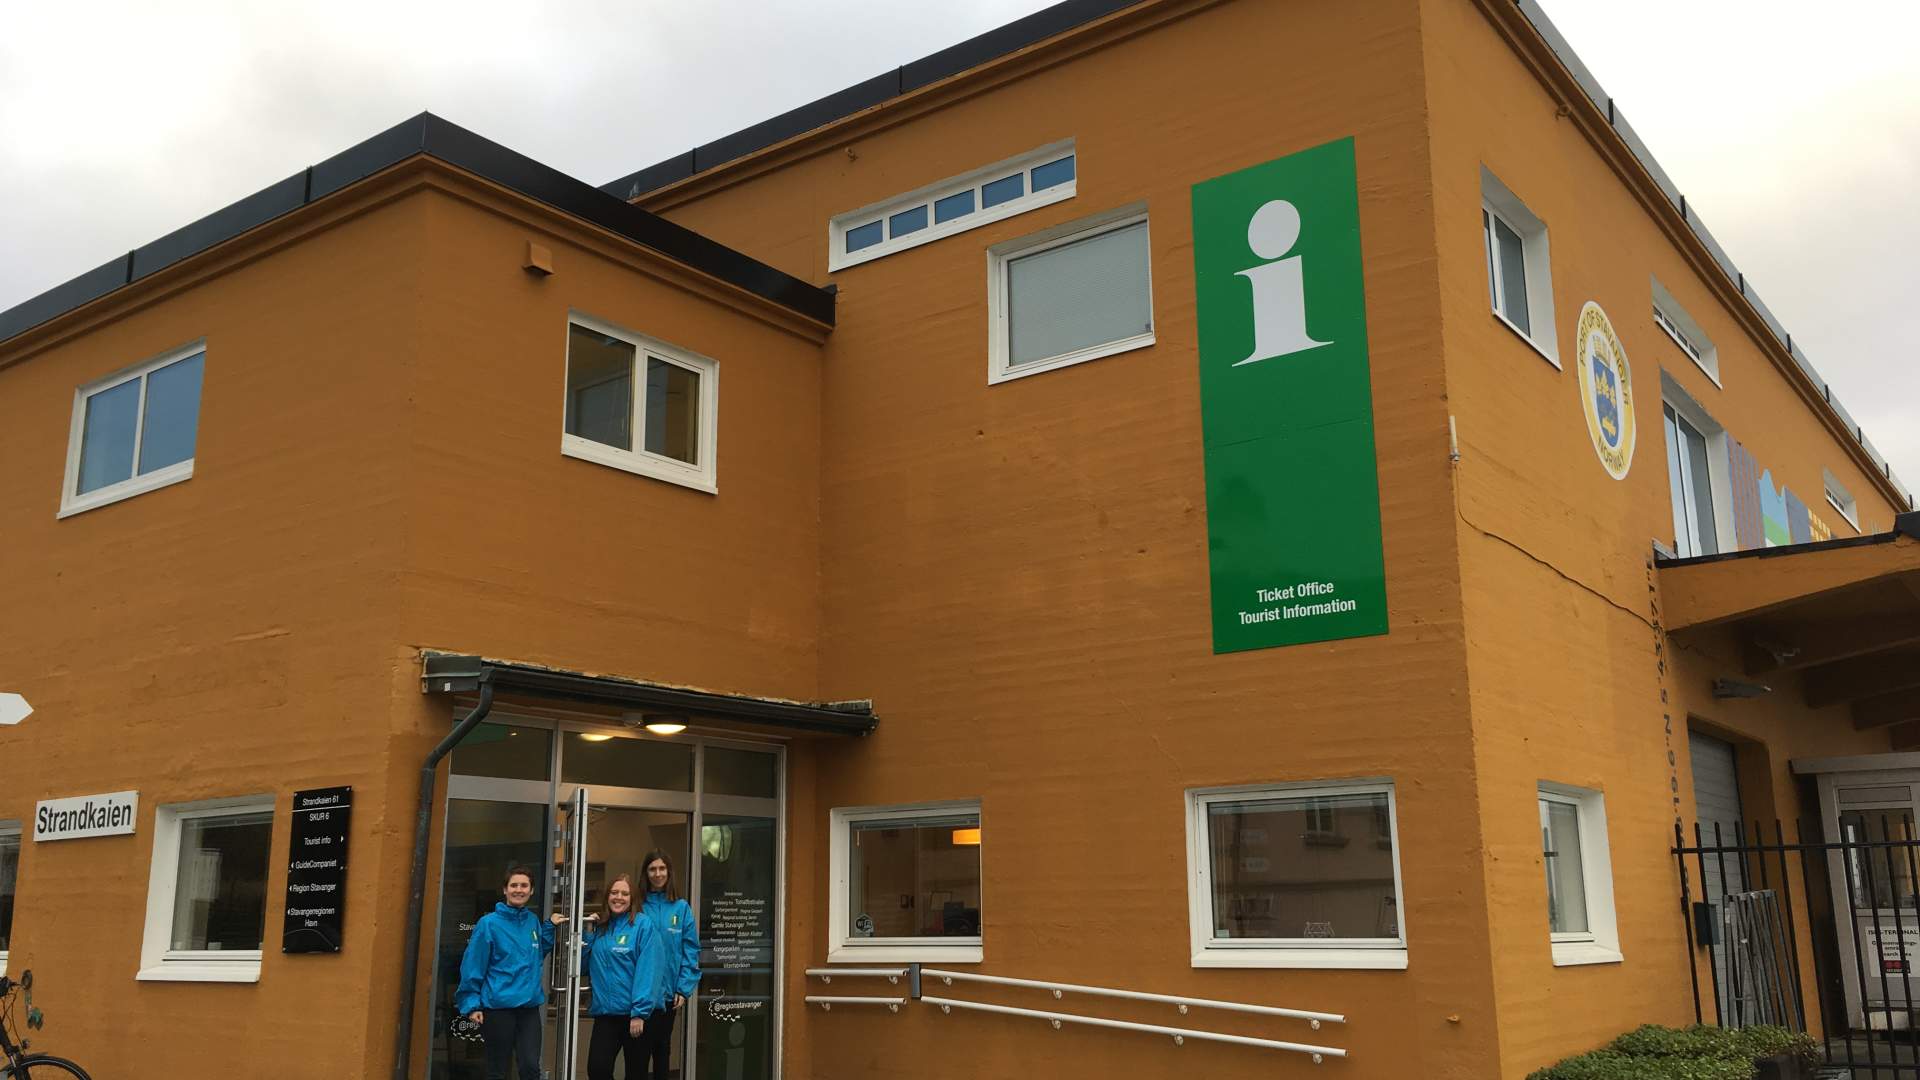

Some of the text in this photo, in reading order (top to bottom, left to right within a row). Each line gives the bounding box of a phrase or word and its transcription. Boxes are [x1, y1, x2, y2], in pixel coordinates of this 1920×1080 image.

[1256, 582, 1335, 603] Ticket Office
[1238, 598, 1356, 625] Tourist Information
[302, 795, 339, 806] Strandkaien 61
[37, 799, 132, 834] Strandkaien
[309, 812, 330, 822] SKUR 6
[304, 835, 331, 846] Tourist info
[292, 883, 336, 894] Region Stavanger
[304, 919, 318, 927] Havn
[714, 1001, 762, 1012] @regionstavanger
